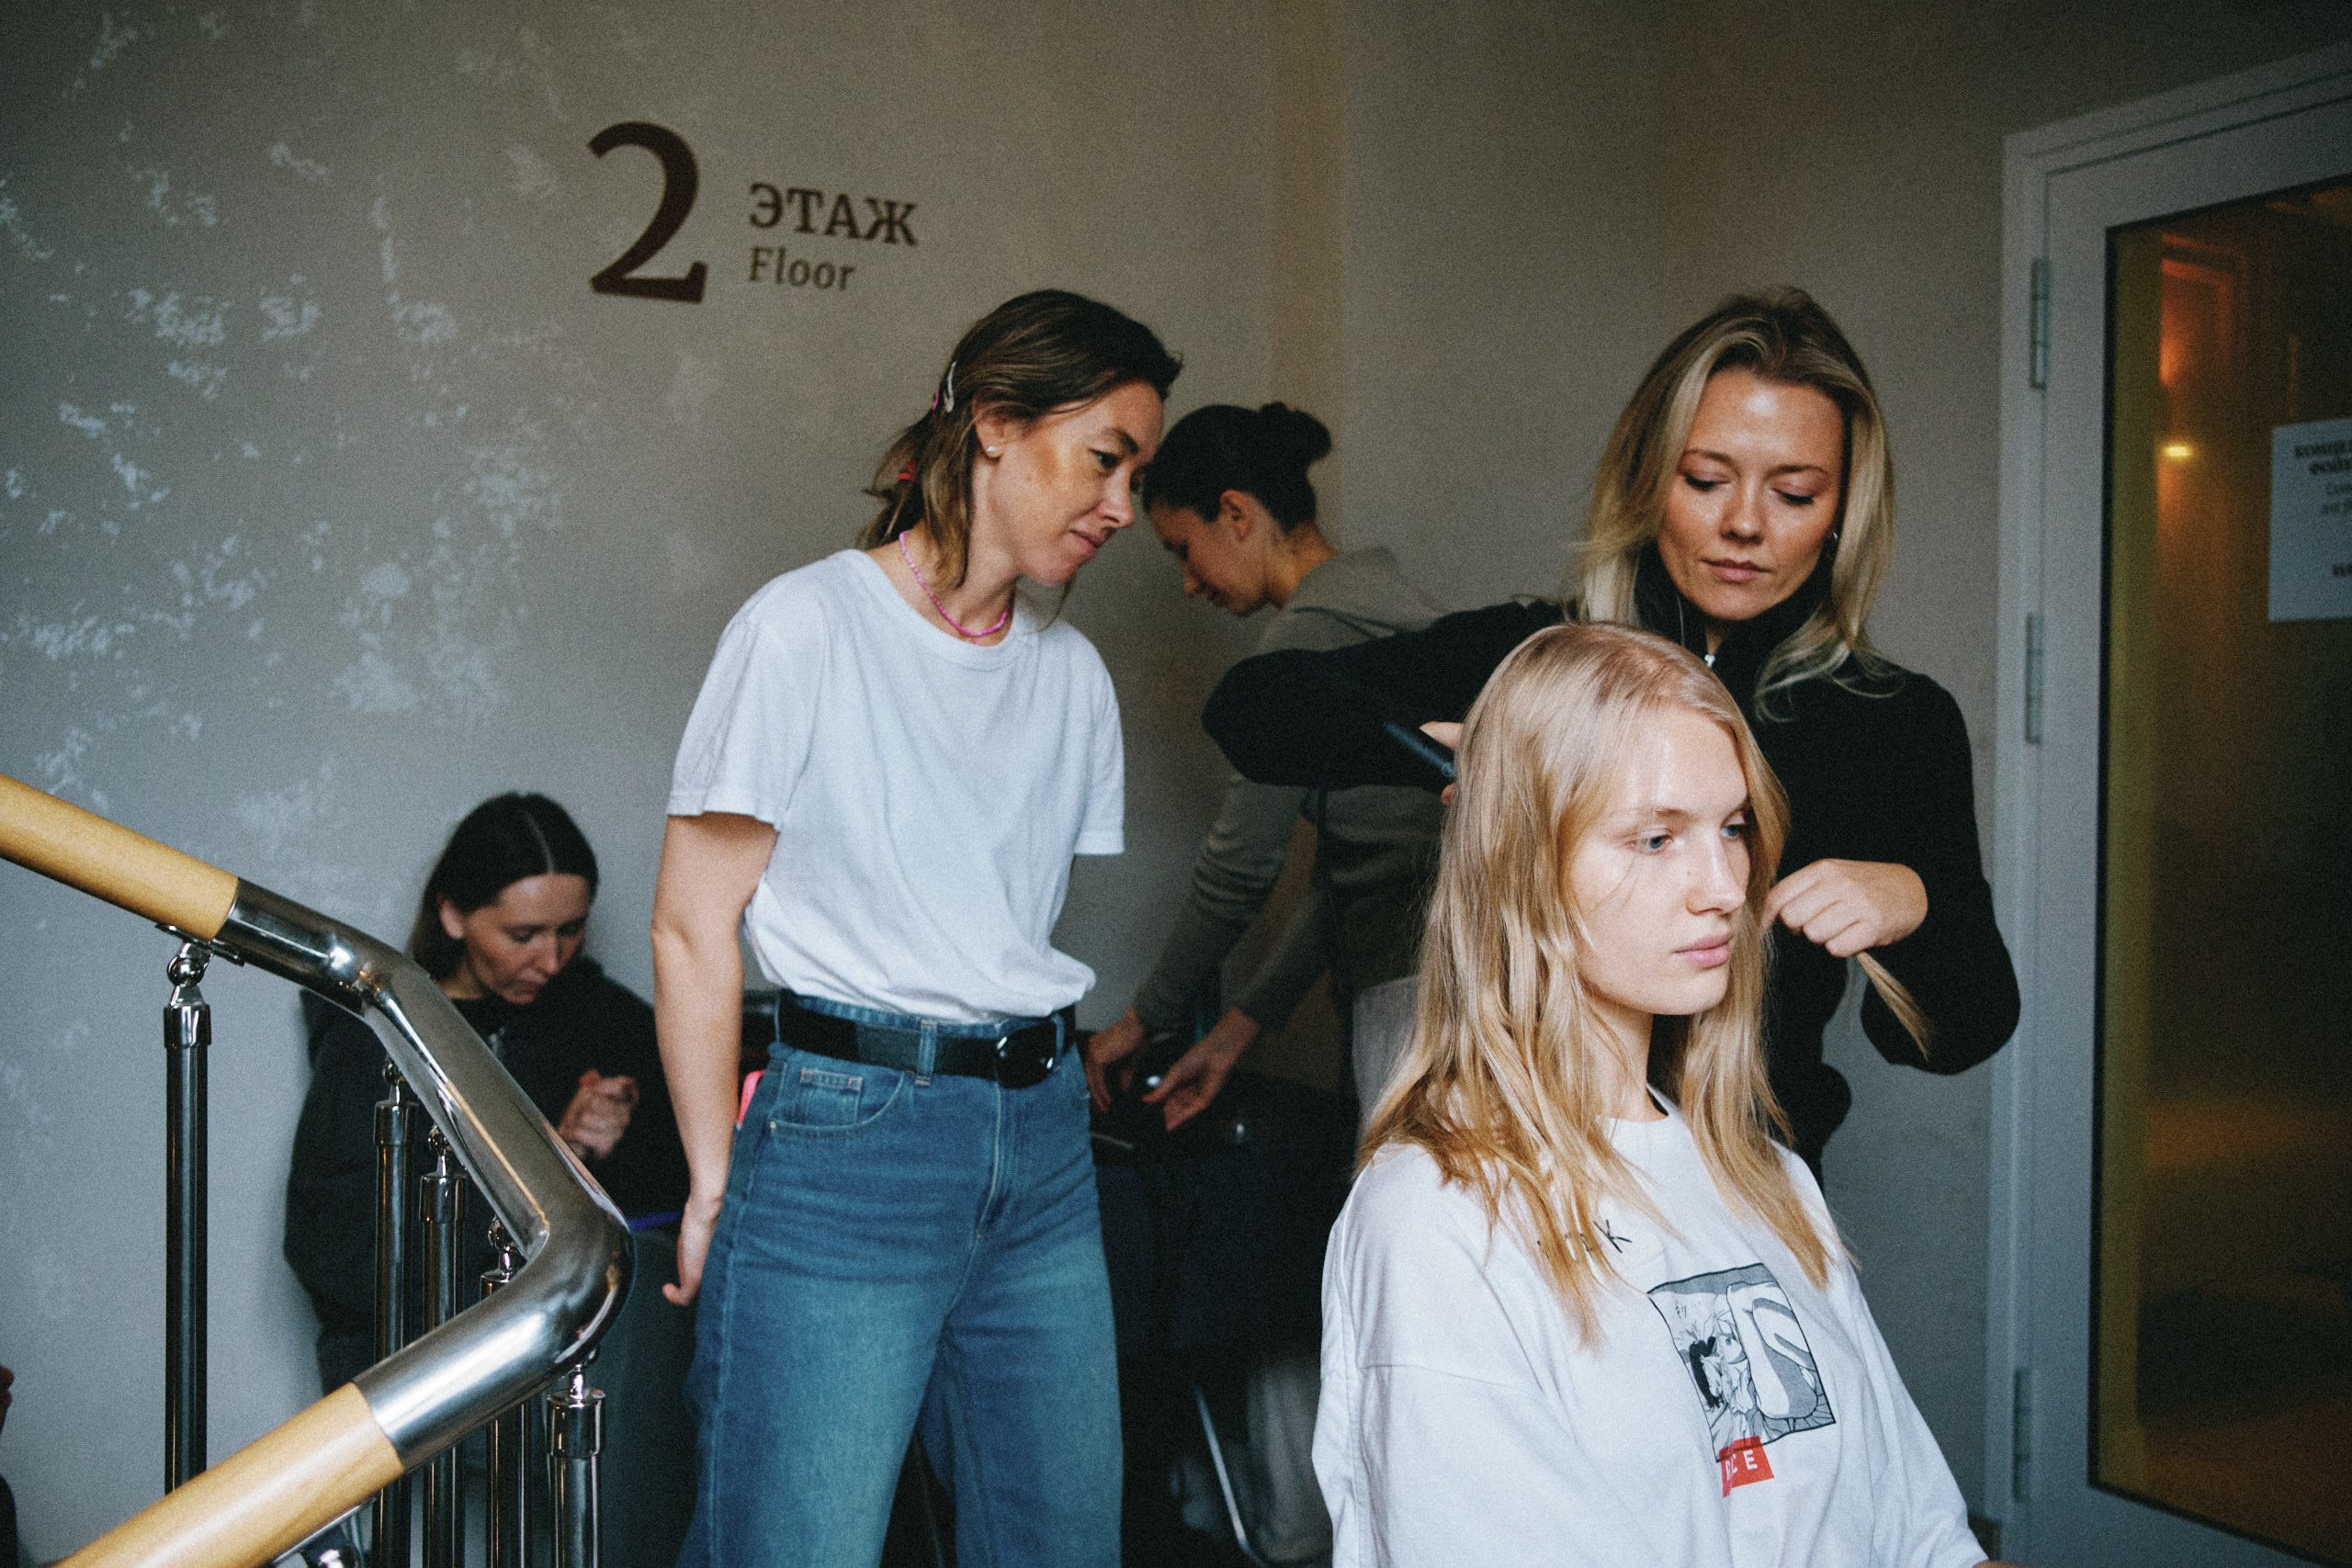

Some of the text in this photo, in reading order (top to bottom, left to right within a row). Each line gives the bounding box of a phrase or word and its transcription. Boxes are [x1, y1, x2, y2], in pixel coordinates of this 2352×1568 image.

[587, 120, 708, 304] 2
[748, 182, 918, 246] ЭТАЖ
[748, 243, 856, 291] Floor
